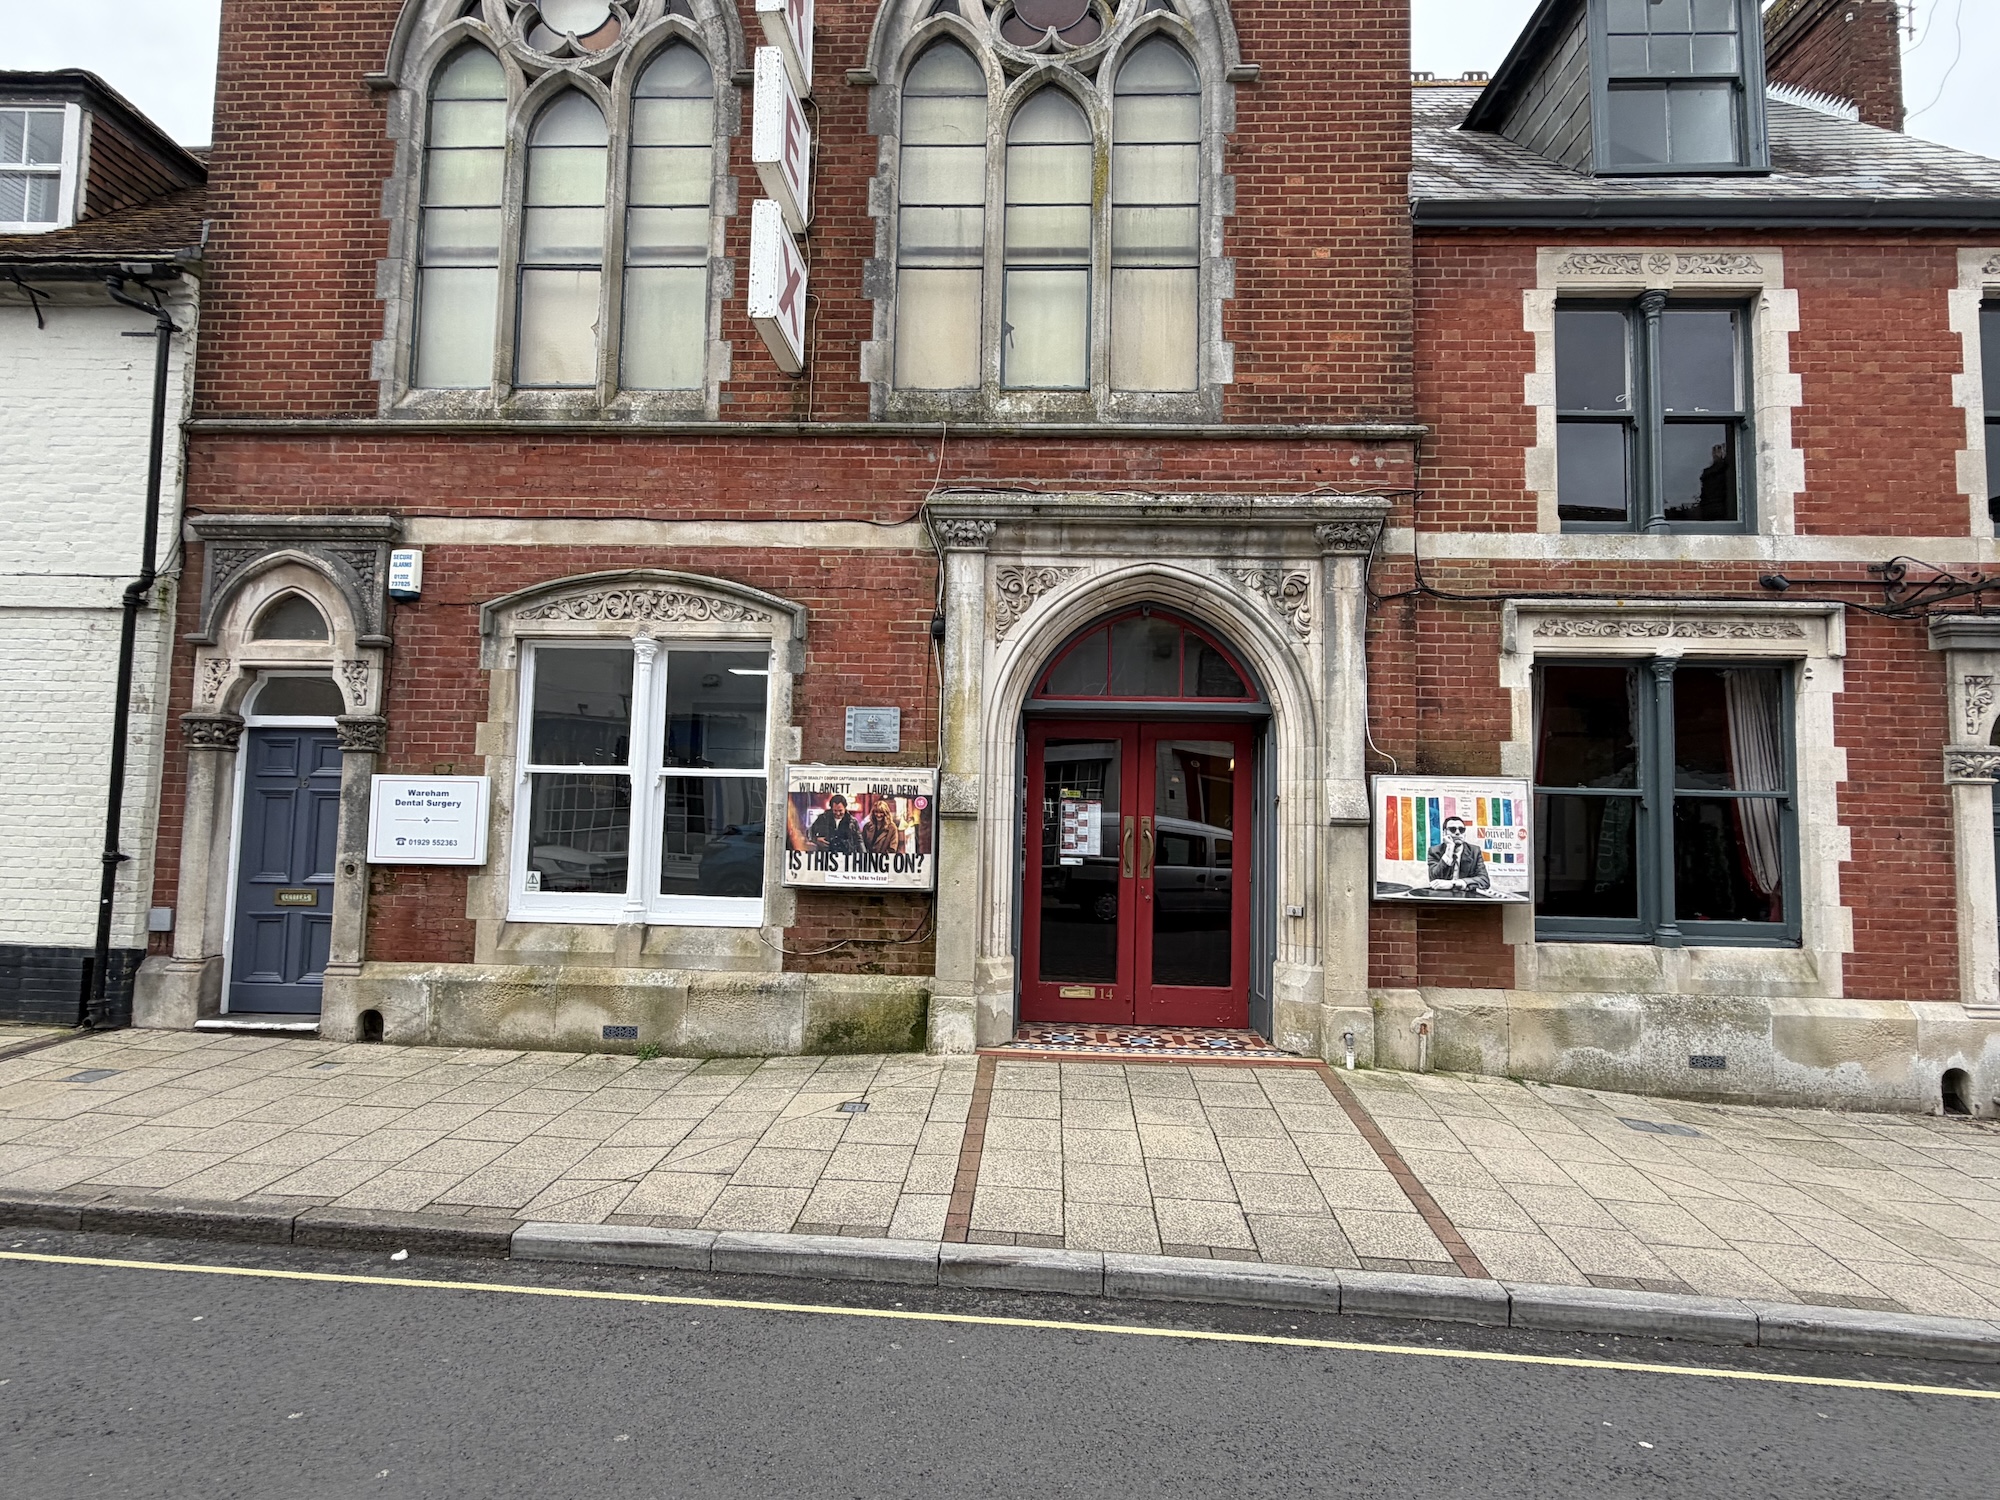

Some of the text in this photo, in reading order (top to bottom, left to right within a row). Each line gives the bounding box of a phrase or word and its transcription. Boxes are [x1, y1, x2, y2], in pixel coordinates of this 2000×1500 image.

[799, 782, 851, 794] WILL ARNETT
[867, 784, 918, 796] LAURA DERN
[426, 800, 462, 808] Surgery
[1477, 828, 1514, 839] Nouvelle
[1484, 839, 1512, 852] Vague
[789, 850, 924, 873] IS THIS THING ON?
[1100, 988, 1113, 1000] 14
